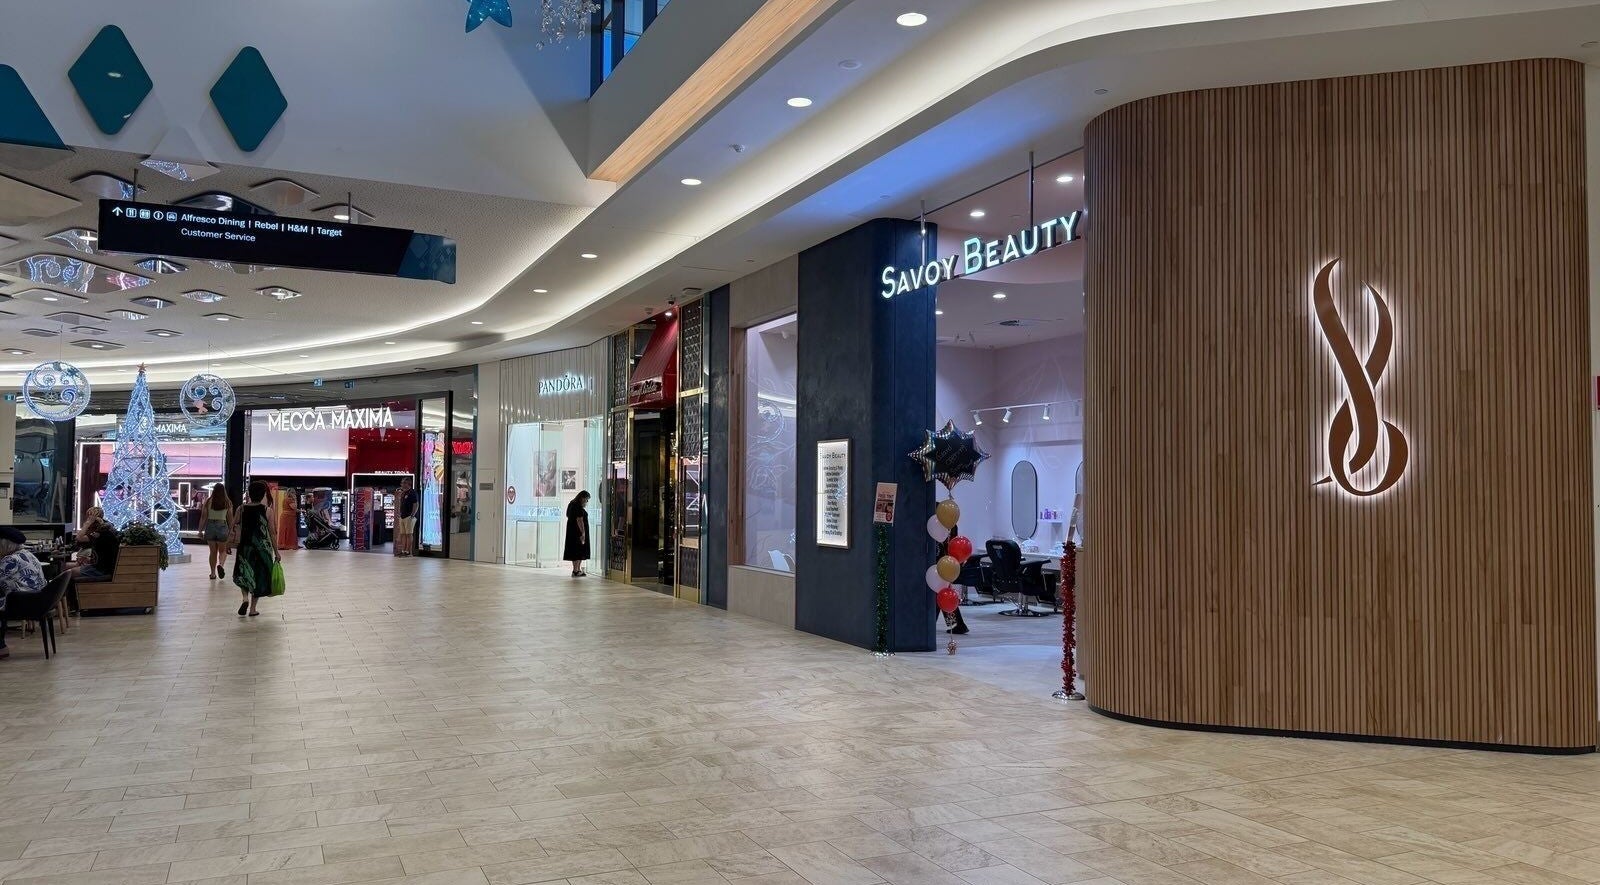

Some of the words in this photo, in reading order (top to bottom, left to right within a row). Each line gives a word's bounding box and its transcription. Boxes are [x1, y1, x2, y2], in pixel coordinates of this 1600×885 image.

[180, 213, 217, 224] Alfresco
[218, 217, 246, 228] Dining
[254, 221, 279, 230] Rebel
[287, 223, 308, 233] H&M
[317, 226, 343, 237] Target
[180, 227, 222, 239] Customer
[224, 232, 256, 242] Service
[881, 254, 959, 299] SAVOY
[964, 211, 1082, 275] BEAUTY
[268, 411, 325, 432] MECCA
[331, 407, 394, 430] MAXIMA
